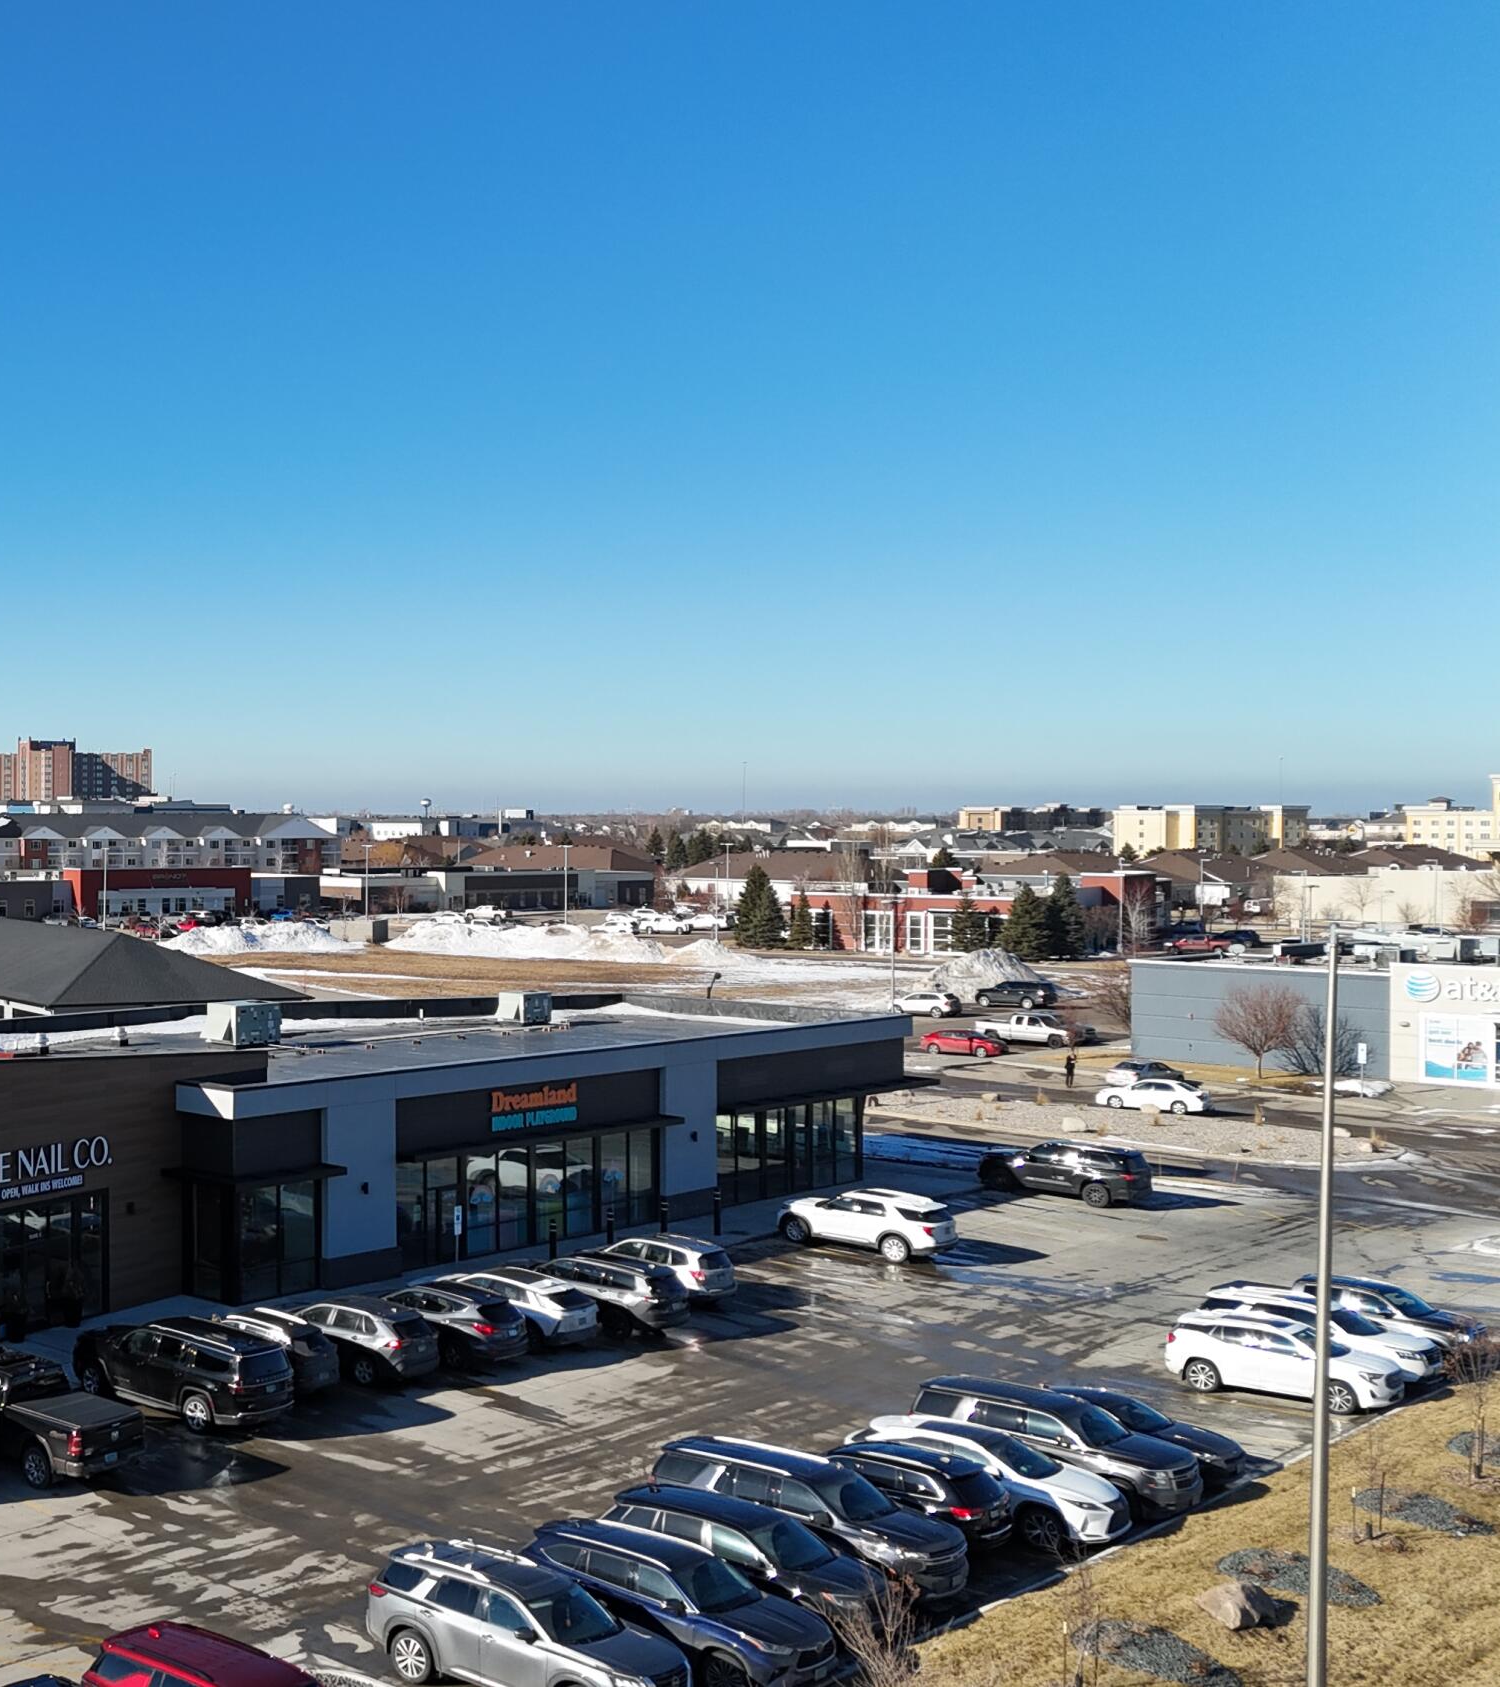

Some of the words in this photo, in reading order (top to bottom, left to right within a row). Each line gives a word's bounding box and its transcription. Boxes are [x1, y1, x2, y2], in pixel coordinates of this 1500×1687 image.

[491, 1082, 577, 1113] Dreamland
[526, 1106, 577, 1127] PLAYGROUND
[18, 1143, 69, 1180] NAIL
[73, 1136, 112, 1169] CO.
[1, 1186, 20, 1199] OPEN,
[21, 1182, 40, 1196] WALK
